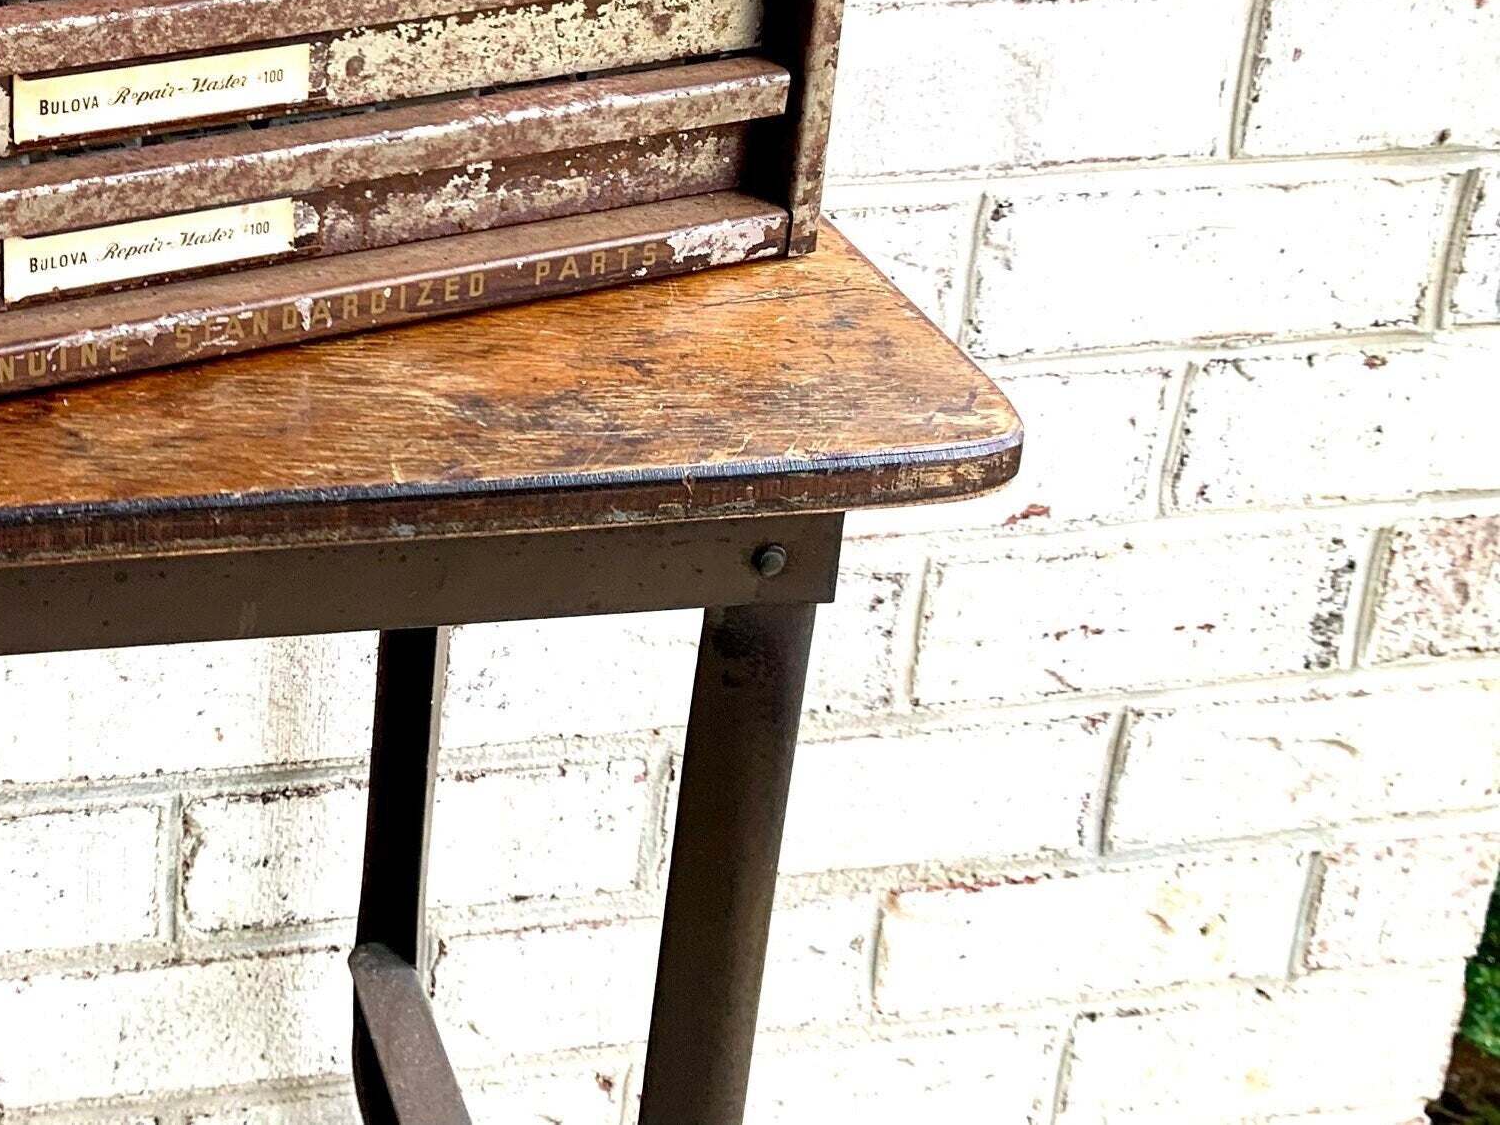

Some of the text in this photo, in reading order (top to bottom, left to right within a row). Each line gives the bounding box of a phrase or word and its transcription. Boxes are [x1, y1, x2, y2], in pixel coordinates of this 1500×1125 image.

[39, 96, 99, 116] BULOVA
[107, 75, 248, 106] Repair-Master
[29, 251, 88, 273] BULOVA
[97, 227, 235, 262] Repair-Master
[534, 242, 658, 286] PARTS
